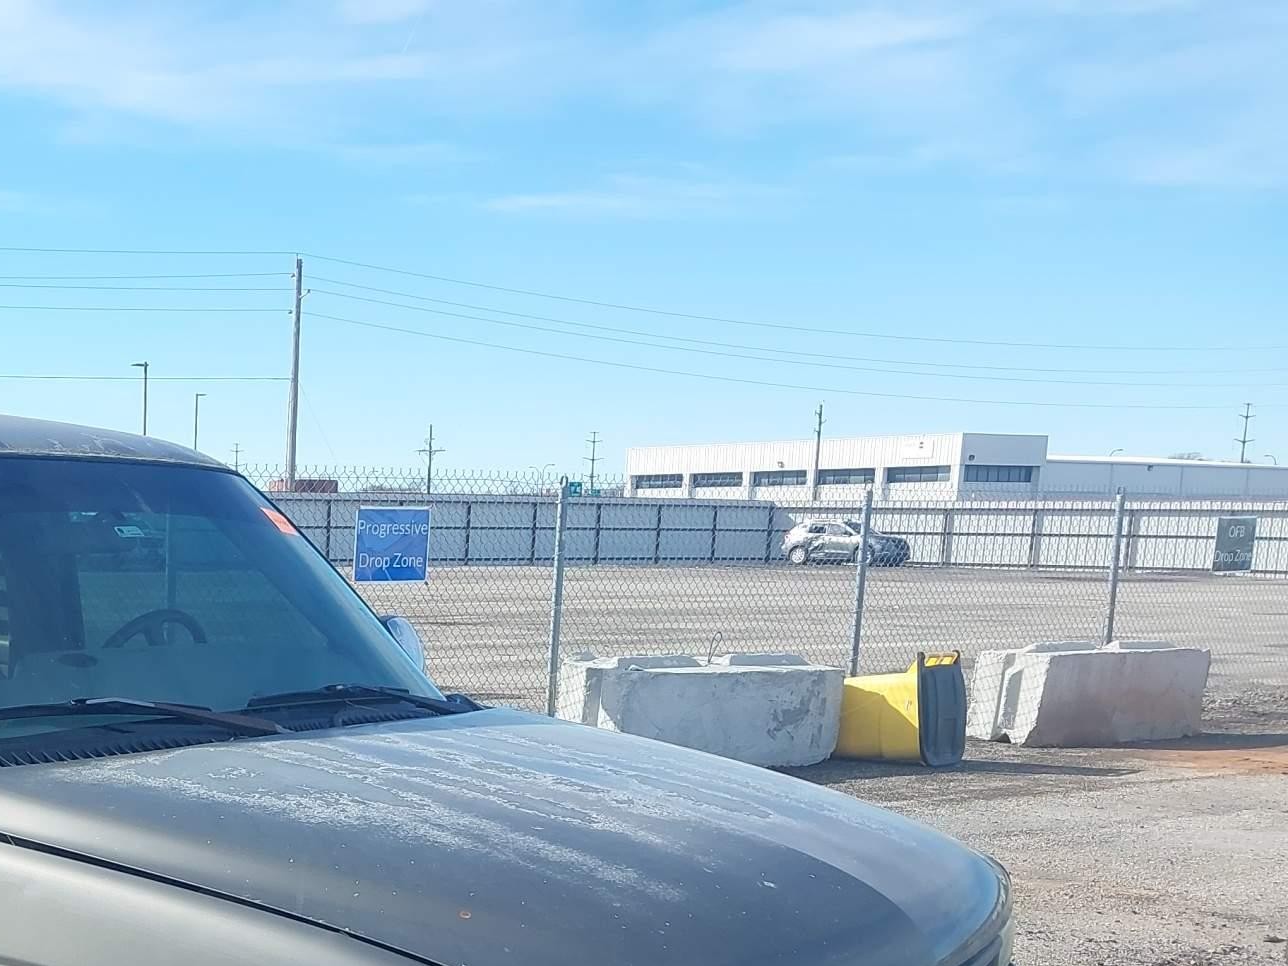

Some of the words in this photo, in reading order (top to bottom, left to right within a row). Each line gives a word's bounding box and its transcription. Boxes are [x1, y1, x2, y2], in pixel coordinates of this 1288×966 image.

[358, 519, 428, 538] Progressive
[359, 552, 390, 571] Drop
[393, 552, 424, 568] Zone
[1214, 550, 1234, 565] Drop
[1234, 549, 1252, 562] Zone
